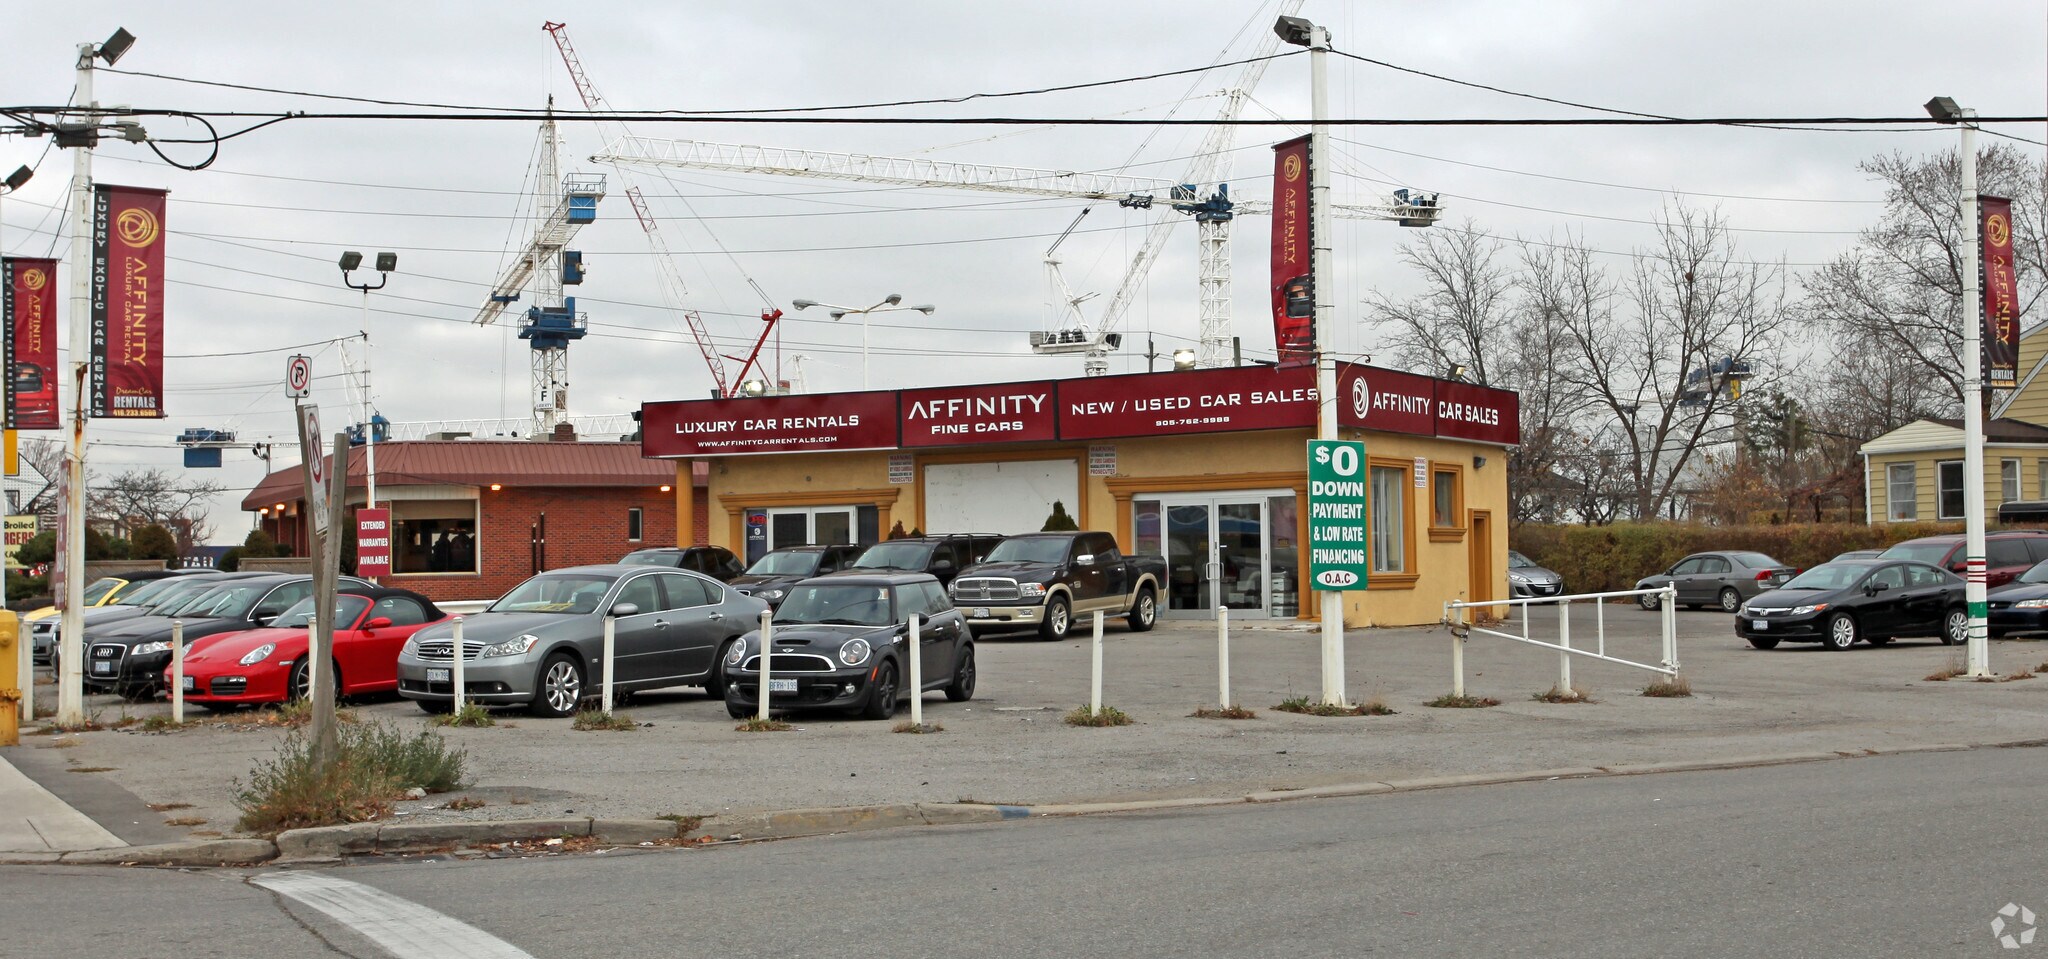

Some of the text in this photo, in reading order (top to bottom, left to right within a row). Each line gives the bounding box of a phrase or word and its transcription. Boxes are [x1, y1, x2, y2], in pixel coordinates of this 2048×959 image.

[1288, 188, 1296, 264] AFFINITY
[93, 195, 107, 416] LUXURY EXOTIC CAR RENTALS
[1998, 255, 2010, 345] AFFINITY
[133, 257, 147, 367] AFFINITY
[33, 295, 41, 353] AFFINITY
[113, 395, 156, 408] RENTALS
[541, 390, 548, 401] F
[1072, 401, 1115, 416] NEW
[1135, 396, 1191, 412] USED
[1200, 393, 1242, 407] CAR
[1250, 388, 1318, 404] SALES
[908, 393, 1047, 420] AFFINITY
[1373, 391, 1499, 426] AFFINITY CAR SALES
[675, 414, 859, 434] LUXURY CAR RENTALS
[931, 421, 1024, 435] FINE CARS
[697, 435, 838, 447] WWW.AFFINITYCARRENTALS.COM
[1315, 445, 1359, 477] $0
[1312, 480, 1364, 497] DOWN
[1313, 502, 1363, 519] PAYMENT
[4, 520, 35, 529] Broiled
[361, 520, 386, 530] EXTENDED
[358, 537, 389, 547] WARRANTIES
[1313, 525, 1363, 542] & LOW RATE
[359, 555, 389, 565] AVAILABLE
[1313, 548, 1365, 565] FINANCING
